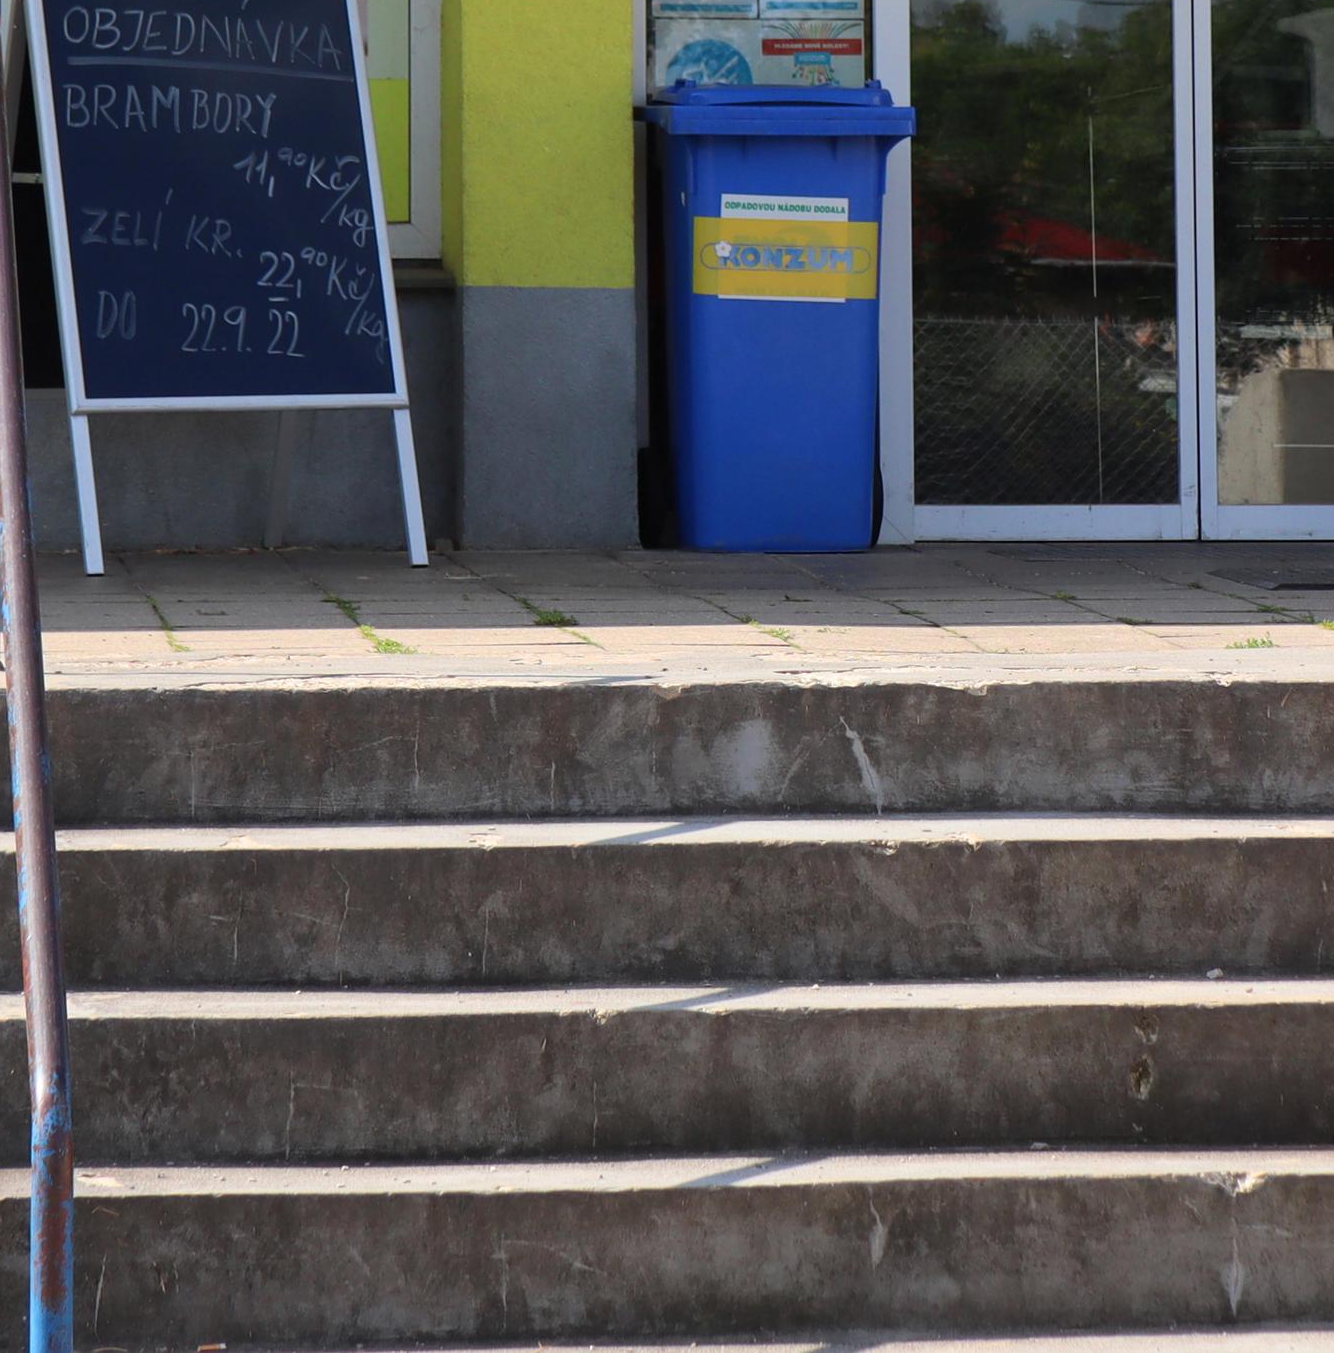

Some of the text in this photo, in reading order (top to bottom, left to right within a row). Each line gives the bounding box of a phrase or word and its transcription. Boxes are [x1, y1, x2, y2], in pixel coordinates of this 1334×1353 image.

[64, 84, 277, 138] BRAMBORY
[81, 188, 174, 251] ZELÍ
[719, 246, 853, 273] KONZUM
[96, 289, 137, 340] DO
